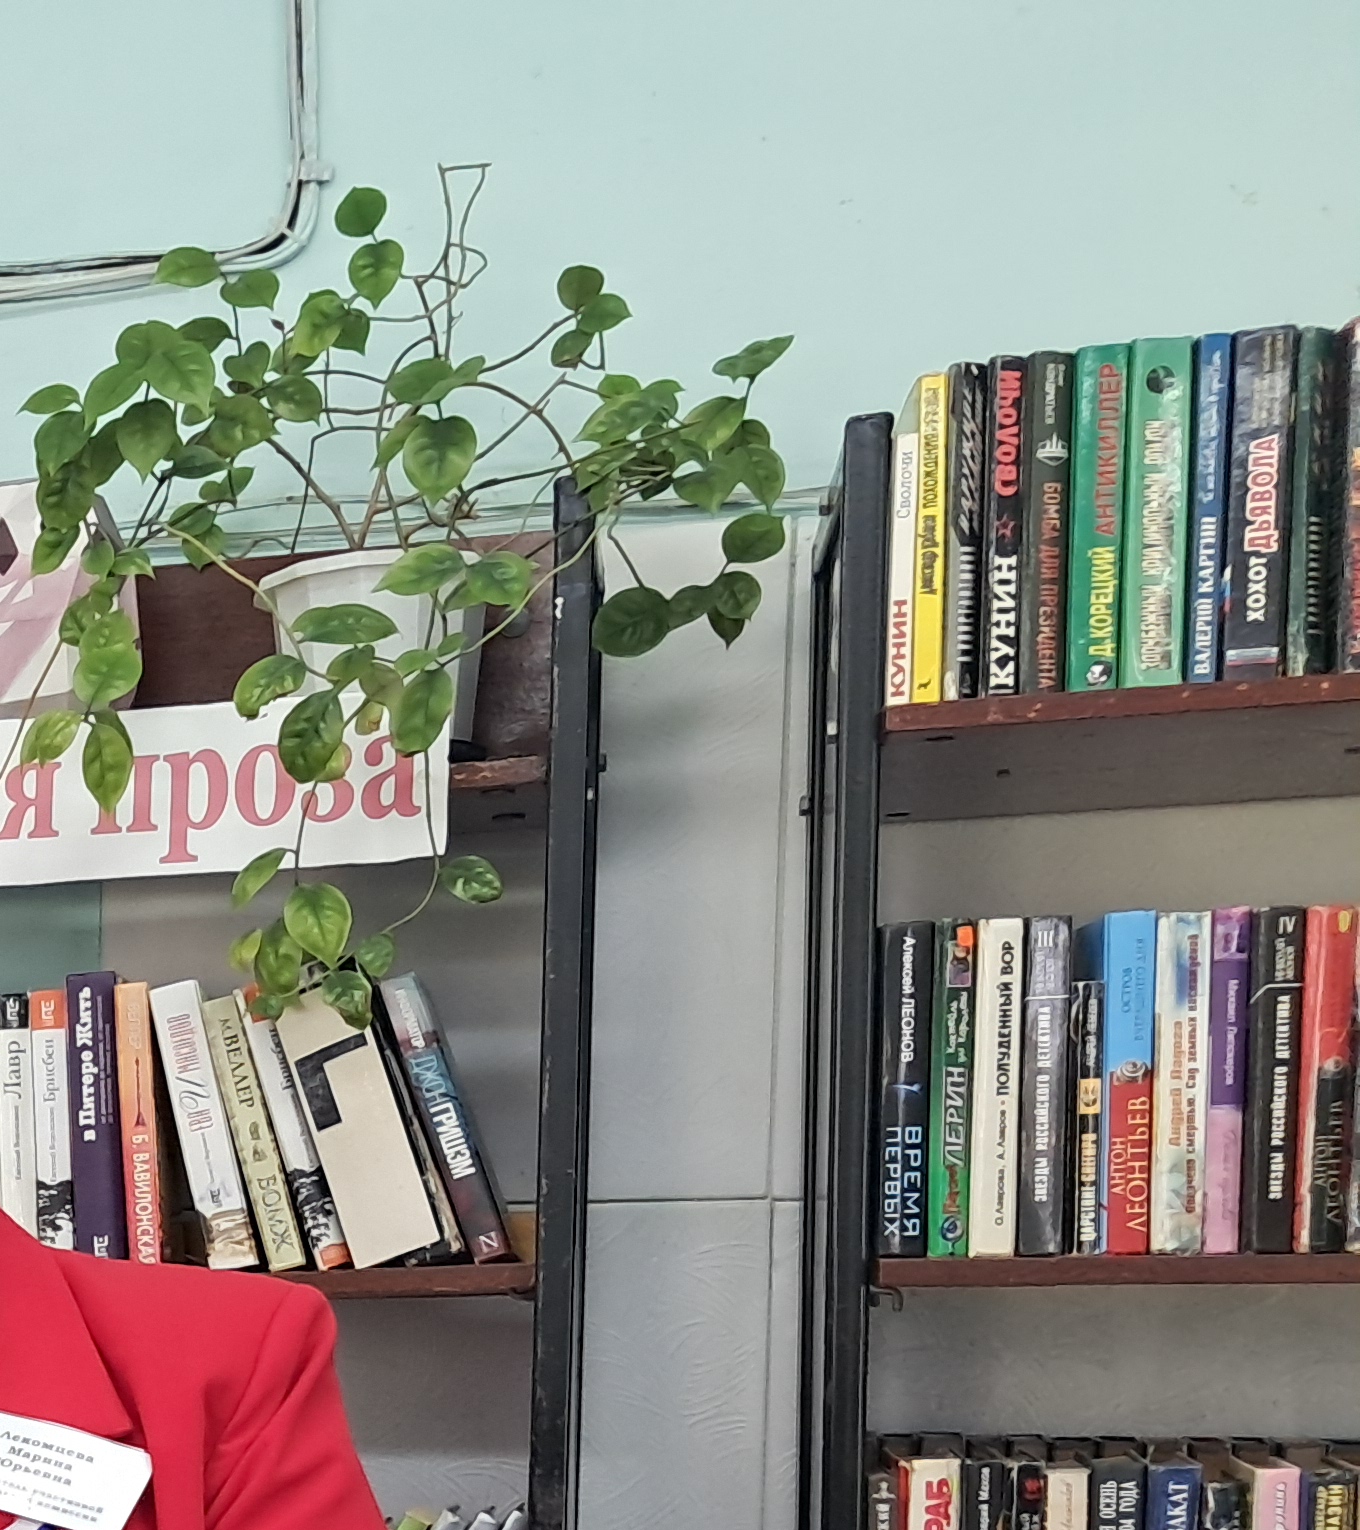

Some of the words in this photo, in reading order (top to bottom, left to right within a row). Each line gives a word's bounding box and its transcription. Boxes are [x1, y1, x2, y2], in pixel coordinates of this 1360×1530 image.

[994, 370, 1022, 496] СВОЛОЧИ
[1094, 362, 1124, 536] АНТИКИЛЛЕР
[896, 450, 914, 518] Сволочи
[1040, 482, 1062, 540] БОМБА
[1244, 432, 1280, 554] ДЬЯВОЛА
[1039, 545, 1060, 577] ДЛЯ
[1246, 555, 1269, 622] ХОХОТ
[989, 554, 1018, 695] КУНИН
[1089, 546, 1117, 657] Д.КОРЕЦКИЙ
[890, 599, 909, 698] КУНИН
[1037, 583, 1060, 689] ПРЕЗИДЕНТА
[1194, 597, 1215, 675] ВАЛЕРИЙ
[1276, 916, 1297, 934] IV
[900, 936, 917, 995] Алексей
[1000, 940, 1016, 979] ВОР
[74, 986, 96, 1047] Жить
[394, 986, 427, 1050] ИНФОРМАТОР
[900, 999, 915, 1063] ЛЕОНОВ
[995, 981, 1014, 1096] ПОЛУДЕННЫЙ
[1038, 1005, 1054, 1069] ДЕТЕКТИВА
[1275, 995, 1291, 1060] ДЕТЕКТИВА
[3, 1040, 26, 1100] Лавр
[41, 1038, 60, 1103] Брисбен
[77, 1050, 98, 1128] Питере
[295, 1031, 368, 1132] Г
[409, 1053, 448, 1106] ДЖОН
[1185, 1067, 1199, 1089] Сад
[83, 1129, 98, 1142] в
[1035, 1074, 1052, 1151] РОССИЙСКОГО
[1167, 1087, 1184, 1147] Андрей
[1185, 1094, 1198, 1154] смертью.
[1270, 1066, 1289, 1147] РОССИЙСКОГО
[131, 1133, 152, 1149] Б.
[427, 1100, 477, 1180] ГРИШЭМ
[1110, 1137, 1129, 1197] АНТОН
[1125, 1096, 1150, 1233] ЛЕОНТЬЕВ
[1313, 1133, 1331, 1188] АНТОН
[1324, 1100, 1346, 1223] ЛЕОНТЬЕВ
[883, 1126, 902, 1237] ПЕРВЫХ
[903, 1126, 923, 1237] ВРЕМЯ
[1033, 1156, 1051, 1203] ЗВЕЗДЫ
[1266, 1152, 1283, 1200] ЗВЕЗДЫ
[255, 1174, 296, 1254] БОМЖ
[0, 1430, 95, 1464] Лекомцева
[7, 1445, 73, 1472] Марина
[1099, 1480, 1118, 1520] ОСЕНЬ
[1118, 1480, 1140, 1513] ГОДА
